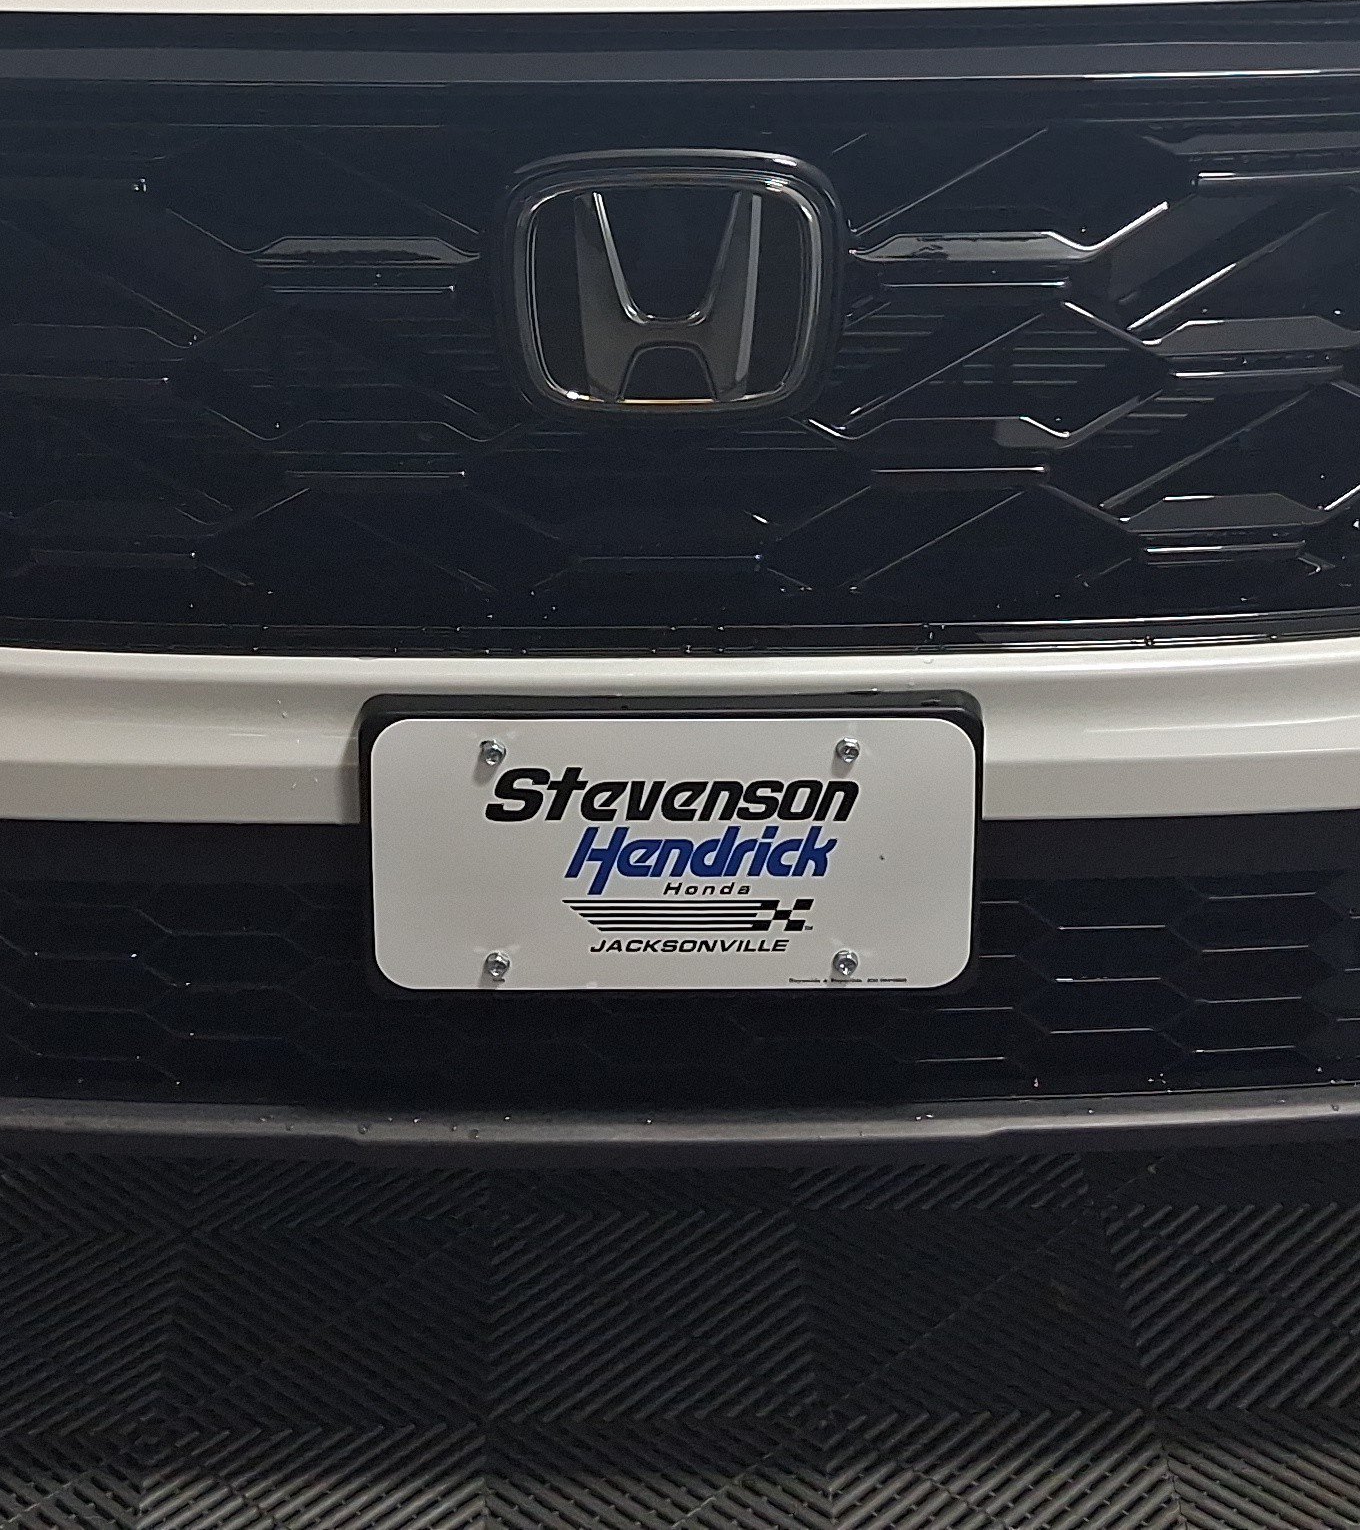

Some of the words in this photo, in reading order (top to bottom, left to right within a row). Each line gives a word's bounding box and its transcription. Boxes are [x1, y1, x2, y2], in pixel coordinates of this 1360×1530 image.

[485, 766, 860, 822] Stevenson
[565, 826, 838, 895] Hendrick
[663, 882, 751, 896] Honda
[590, 939, 790, 953] JACKSONVILLE
